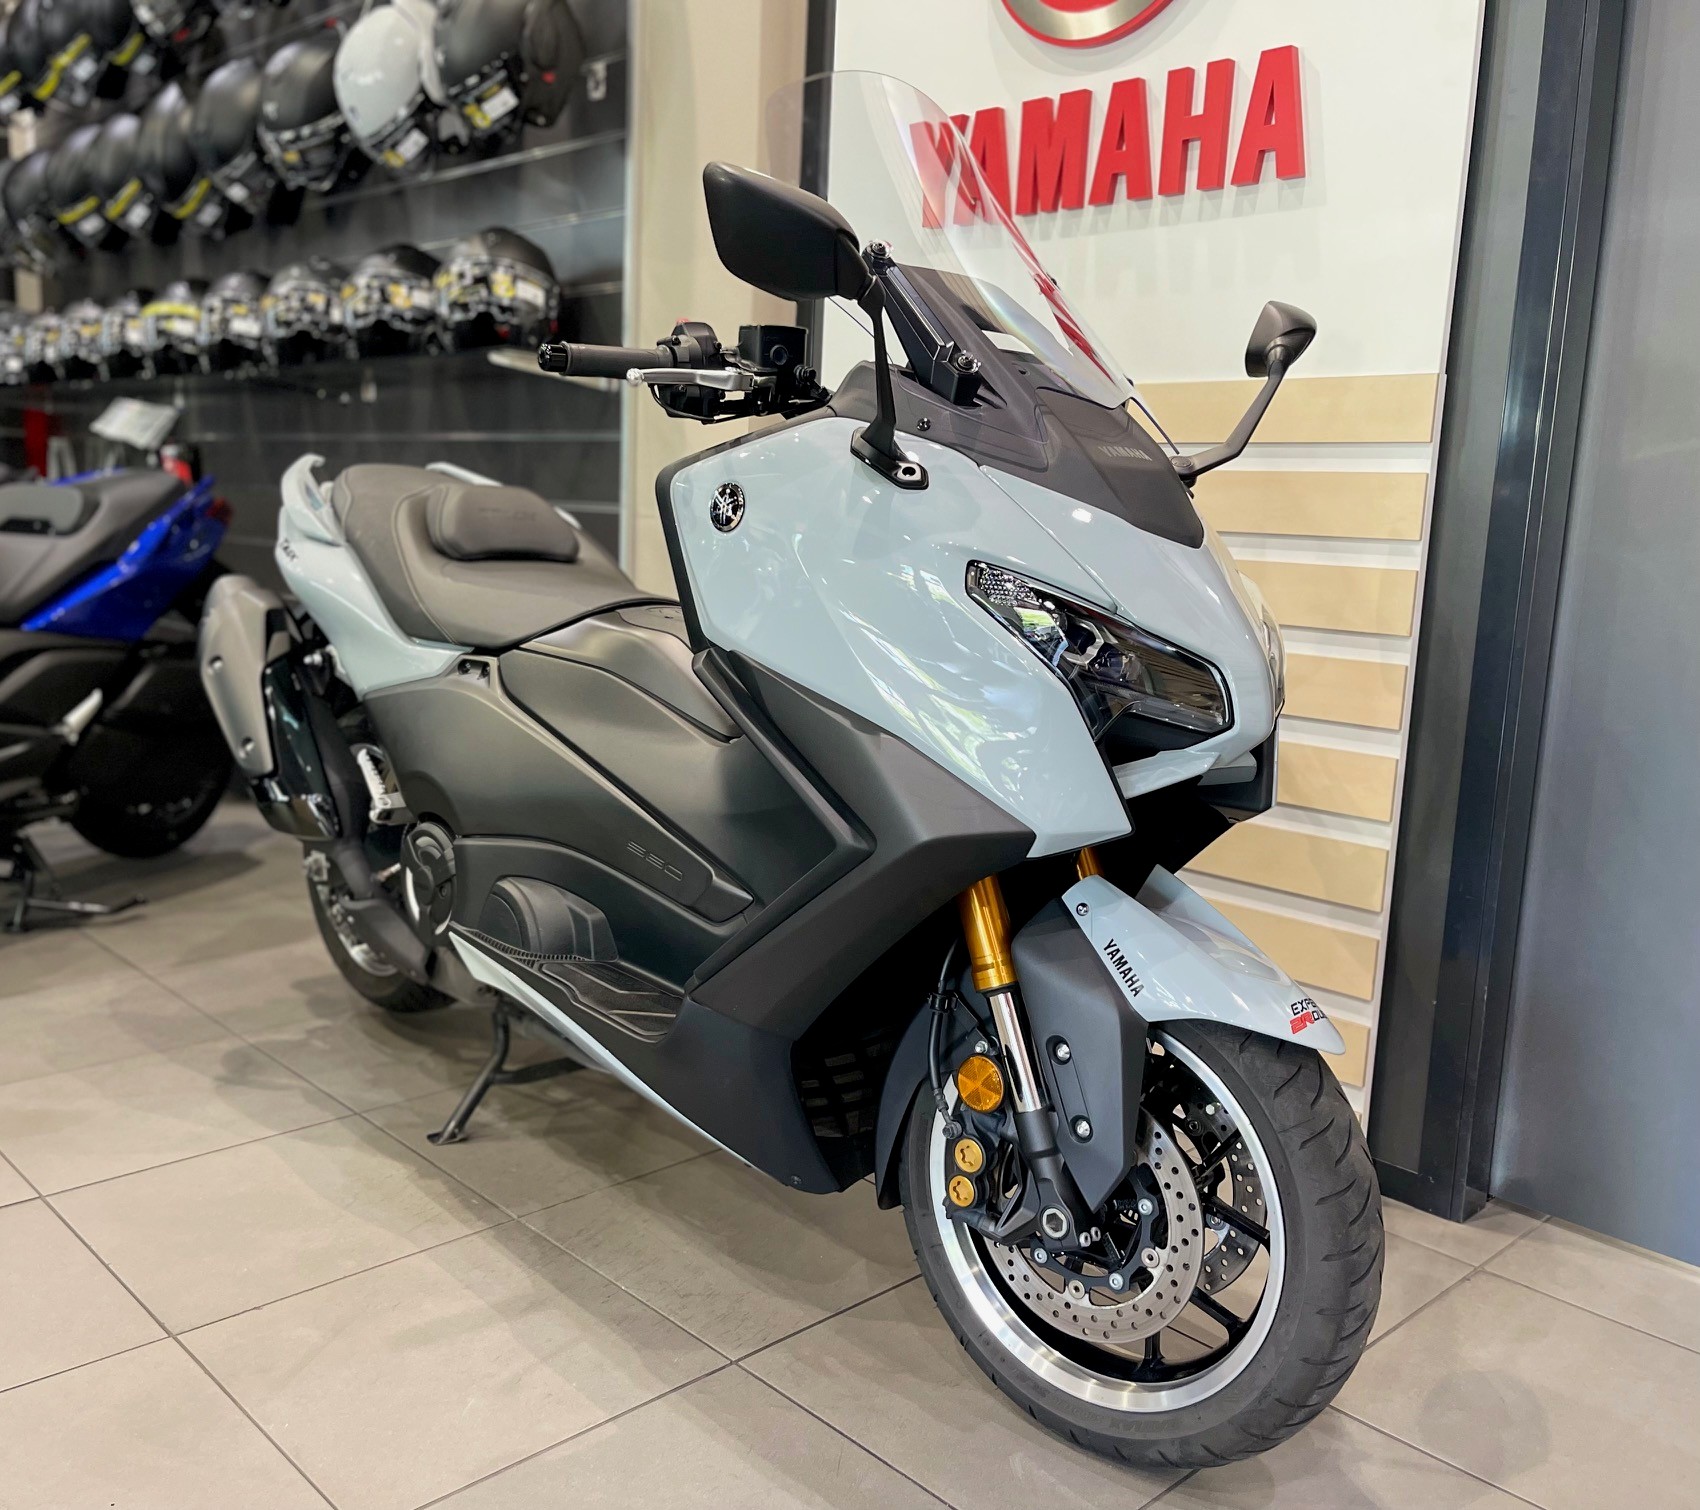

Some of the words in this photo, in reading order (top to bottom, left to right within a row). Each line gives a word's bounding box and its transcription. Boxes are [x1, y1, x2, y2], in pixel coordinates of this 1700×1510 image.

[909, 45, 1306, 229] YAMAHA
[1098, 446, 1153, 462] YAMAHA
[1103, 939, 1145, 998] YAMAHA
